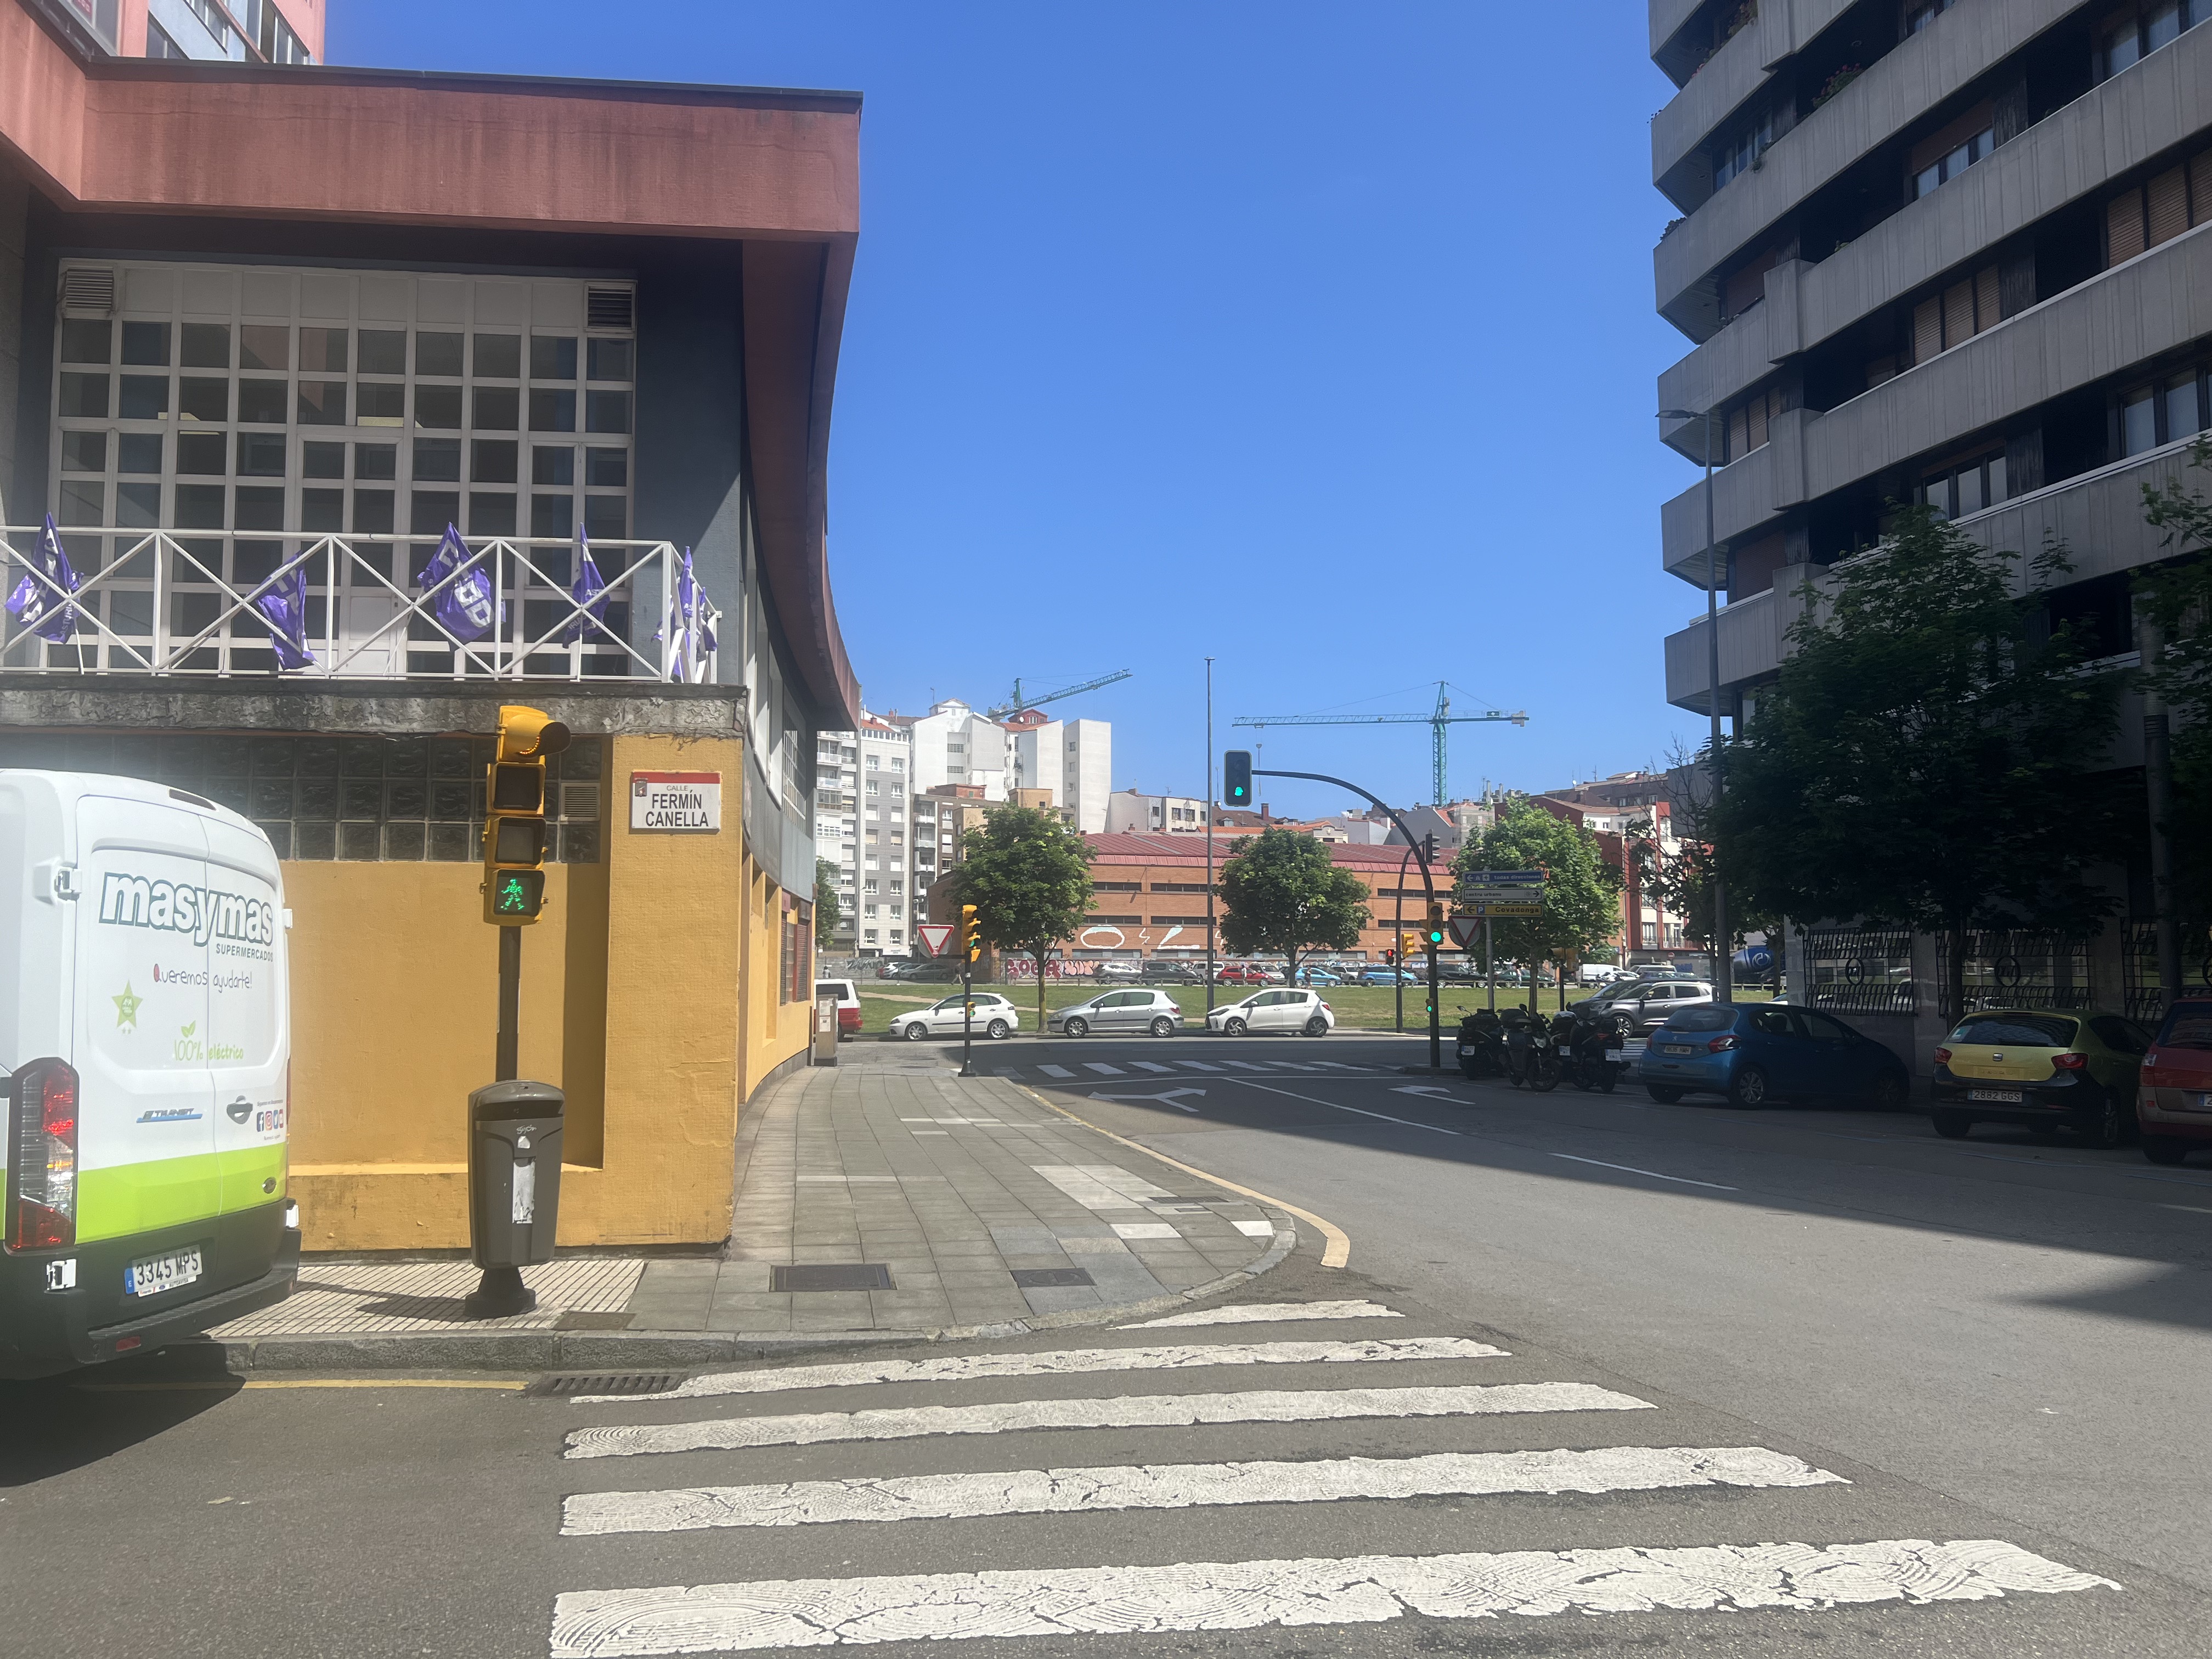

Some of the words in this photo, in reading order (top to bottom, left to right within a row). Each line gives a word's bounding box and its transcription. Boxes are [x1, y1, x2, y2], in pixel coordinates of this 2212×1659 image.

[652, 789, 702, 809] FERMÍN
[646, 811, 709, 827] CANELLA
[99, 871, 273, 947] masymas
[216, 943, 273, 962] SUPERMERCADOS
[154, 963, 208, 985] Queremos
[213, 969, 252, 994] ayudarte!
[174, 1039, 203, 1061] 100%
[208, 1042, 244, 1060] eléctrico
[2001, 1091, 2020, 1101] GGS
[137, 1256, 172, 1286] 3345
[176, 1250, 198, 1276] MPS
